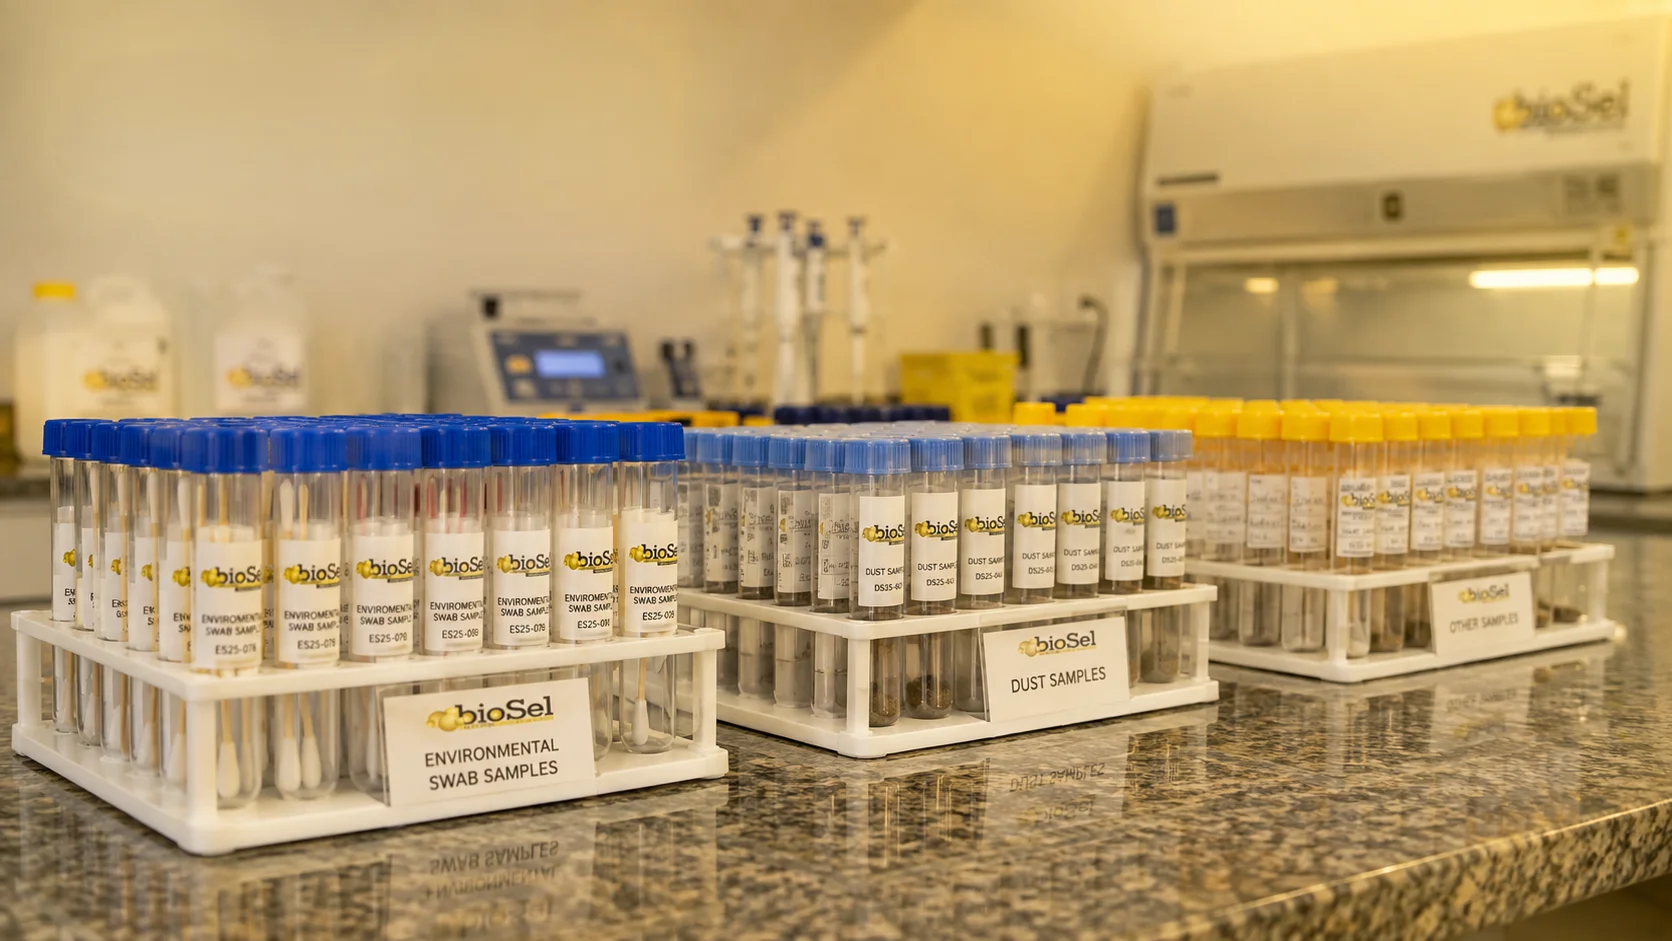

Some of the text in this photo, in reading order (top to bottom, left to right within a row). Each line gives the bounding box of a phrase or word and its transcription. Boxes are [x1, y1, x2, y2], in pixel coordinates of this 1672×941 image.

[968, 557, 987, 565] DUST
[865, 567, 886, 576] DUST
[917, 563, 938, 571] DUST
[633, 596, 657, 605] SWAB
[501, 608, 524, 617] SWAB
[568, 604, 592, 613] SWAB
[360, 616, 385, 626] SWAB
[433, 612, 458, 622] SWAB
[288, 622, 314, 632] SWAB
[1450, 612, 1519, 633] OTHER SAMPLES
[205, 626, 232, 636] SWAB
[1034, 630, 1097, 652] bioSel
[1011, 666, 1106, 693] DUST SAMPLES
[454, 695, 554, 726] bioSel
[425, 738, 559, 767] ENVIRONMENTAL
[429, 760, 558, 790] SWAB SAMPLES
